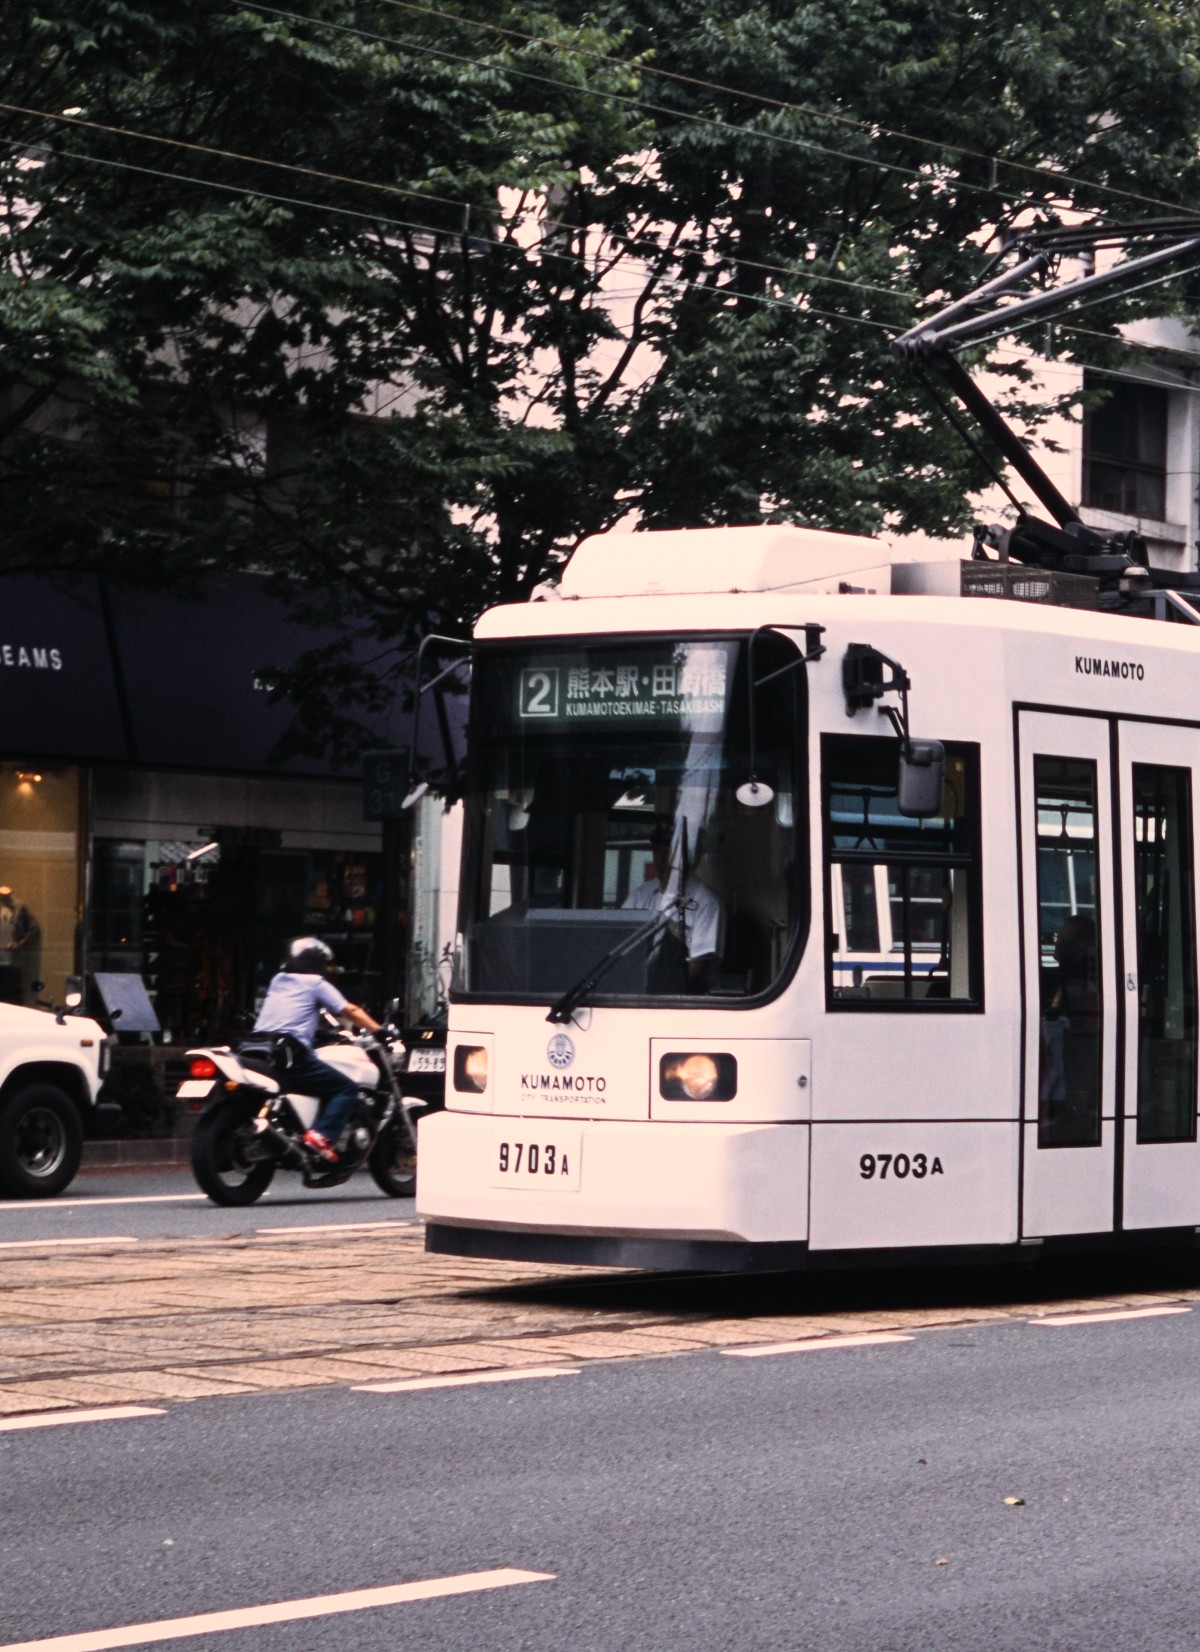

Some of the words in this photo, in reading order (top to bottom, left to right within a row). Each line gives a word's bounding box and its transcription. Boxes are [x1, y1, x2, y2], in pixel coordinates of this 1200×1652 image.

[0, 645, 62, 670] EAMS
[1075, 656, 1144, 681] KUMAMOTO
[527, 672, 551, 712] 2
[520, 1074, 607, 1092] KUMAMOTO
[499, 1142, 569, 1176] 9703A
[860, 1153, 944, 1180] 9703A
